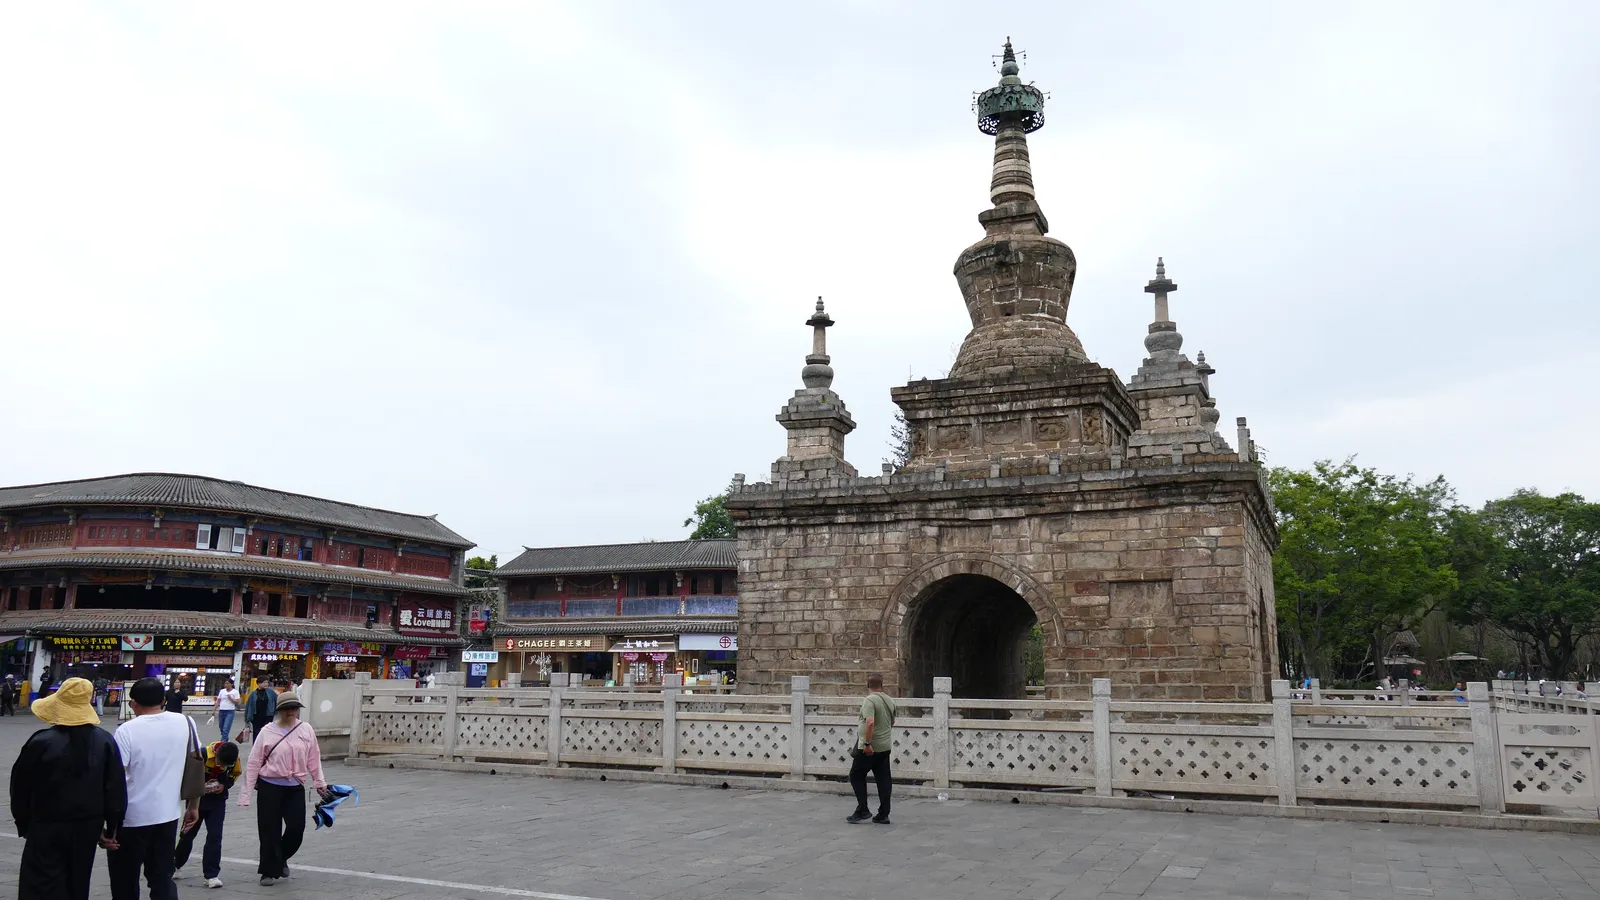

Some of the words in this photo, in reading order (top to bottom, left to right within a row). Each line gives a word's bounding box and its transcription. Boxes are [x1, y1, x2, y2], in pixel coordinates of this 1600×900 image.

[400, 610, 412, 625] 爱
[417, 608, 451, 619] 云端旅拍
[253, 638, 299, 651] 文创市集
[518, 640, 556, 648] CHAGEE
